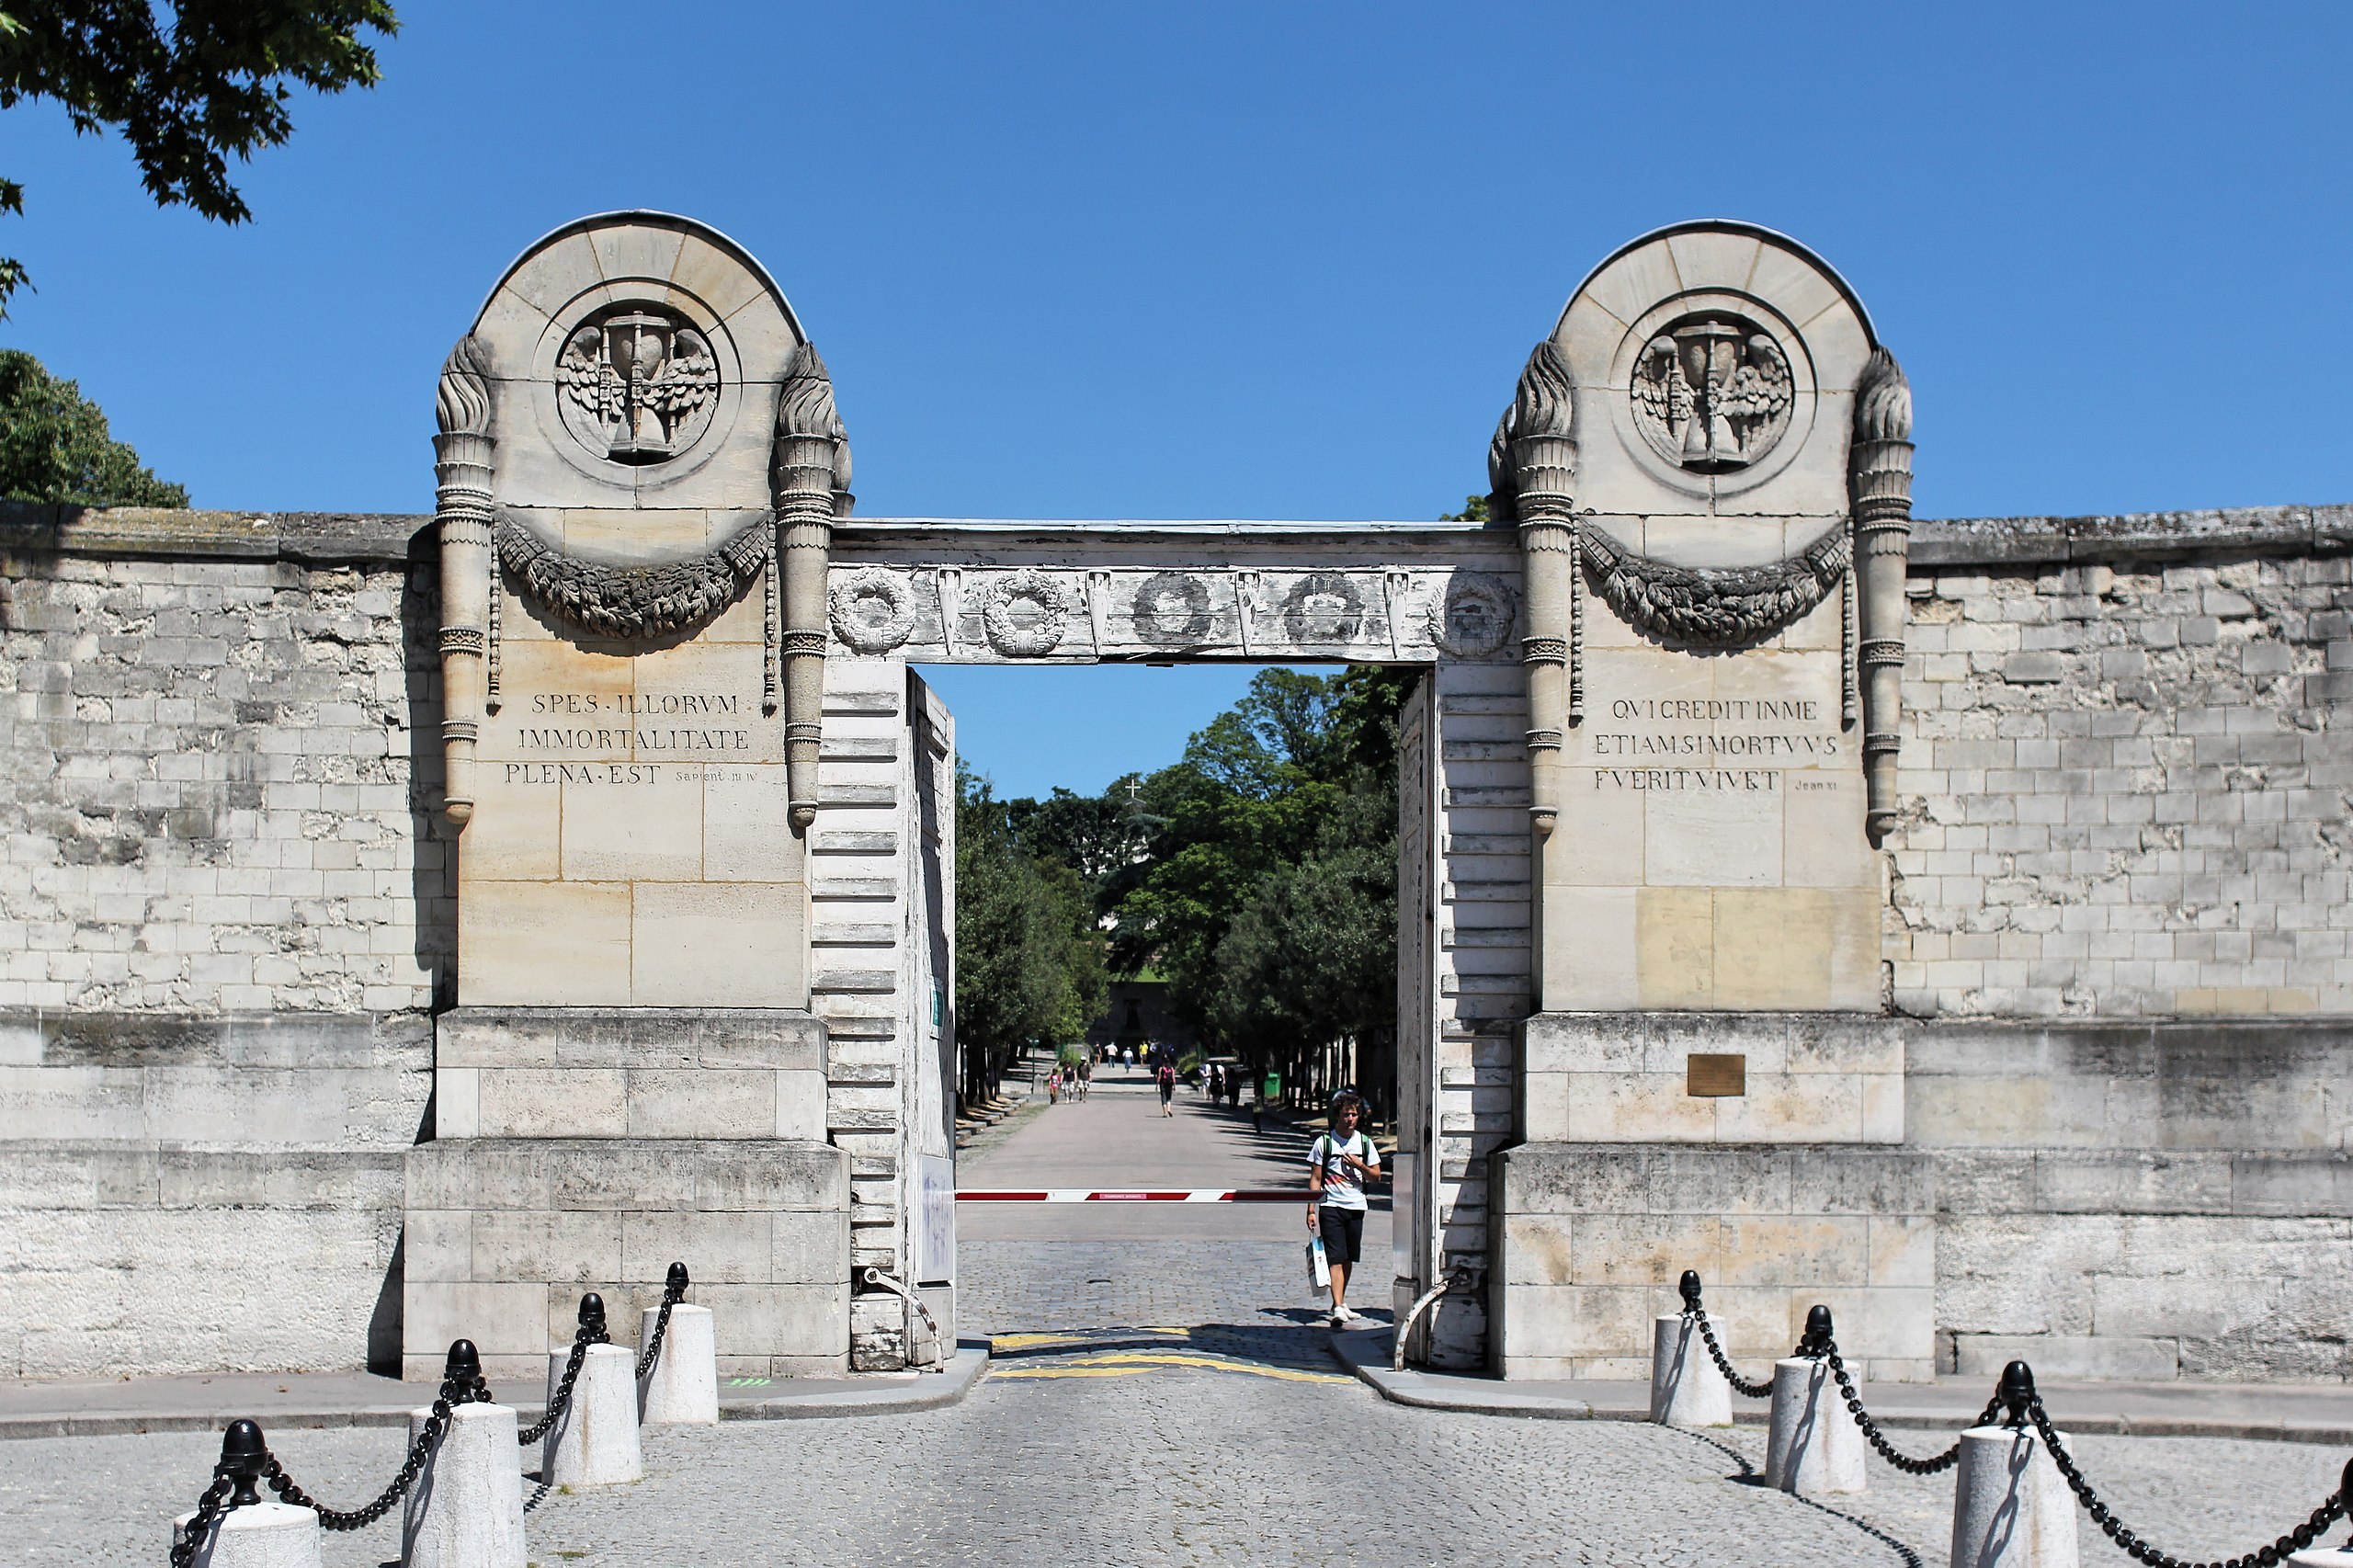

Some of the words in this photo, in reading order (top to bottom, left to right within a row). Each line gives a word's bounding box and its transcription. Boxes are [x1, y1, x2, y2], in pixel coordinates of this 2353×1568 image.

[531, 694, 598, 714] SPES
[617, 694, 738, 714] ILLORVM
[518, 729, 750, 750] IMMORTALITATE
[505, 763, 594, 785] PLENA
[608, 765, 661, 785] EST
